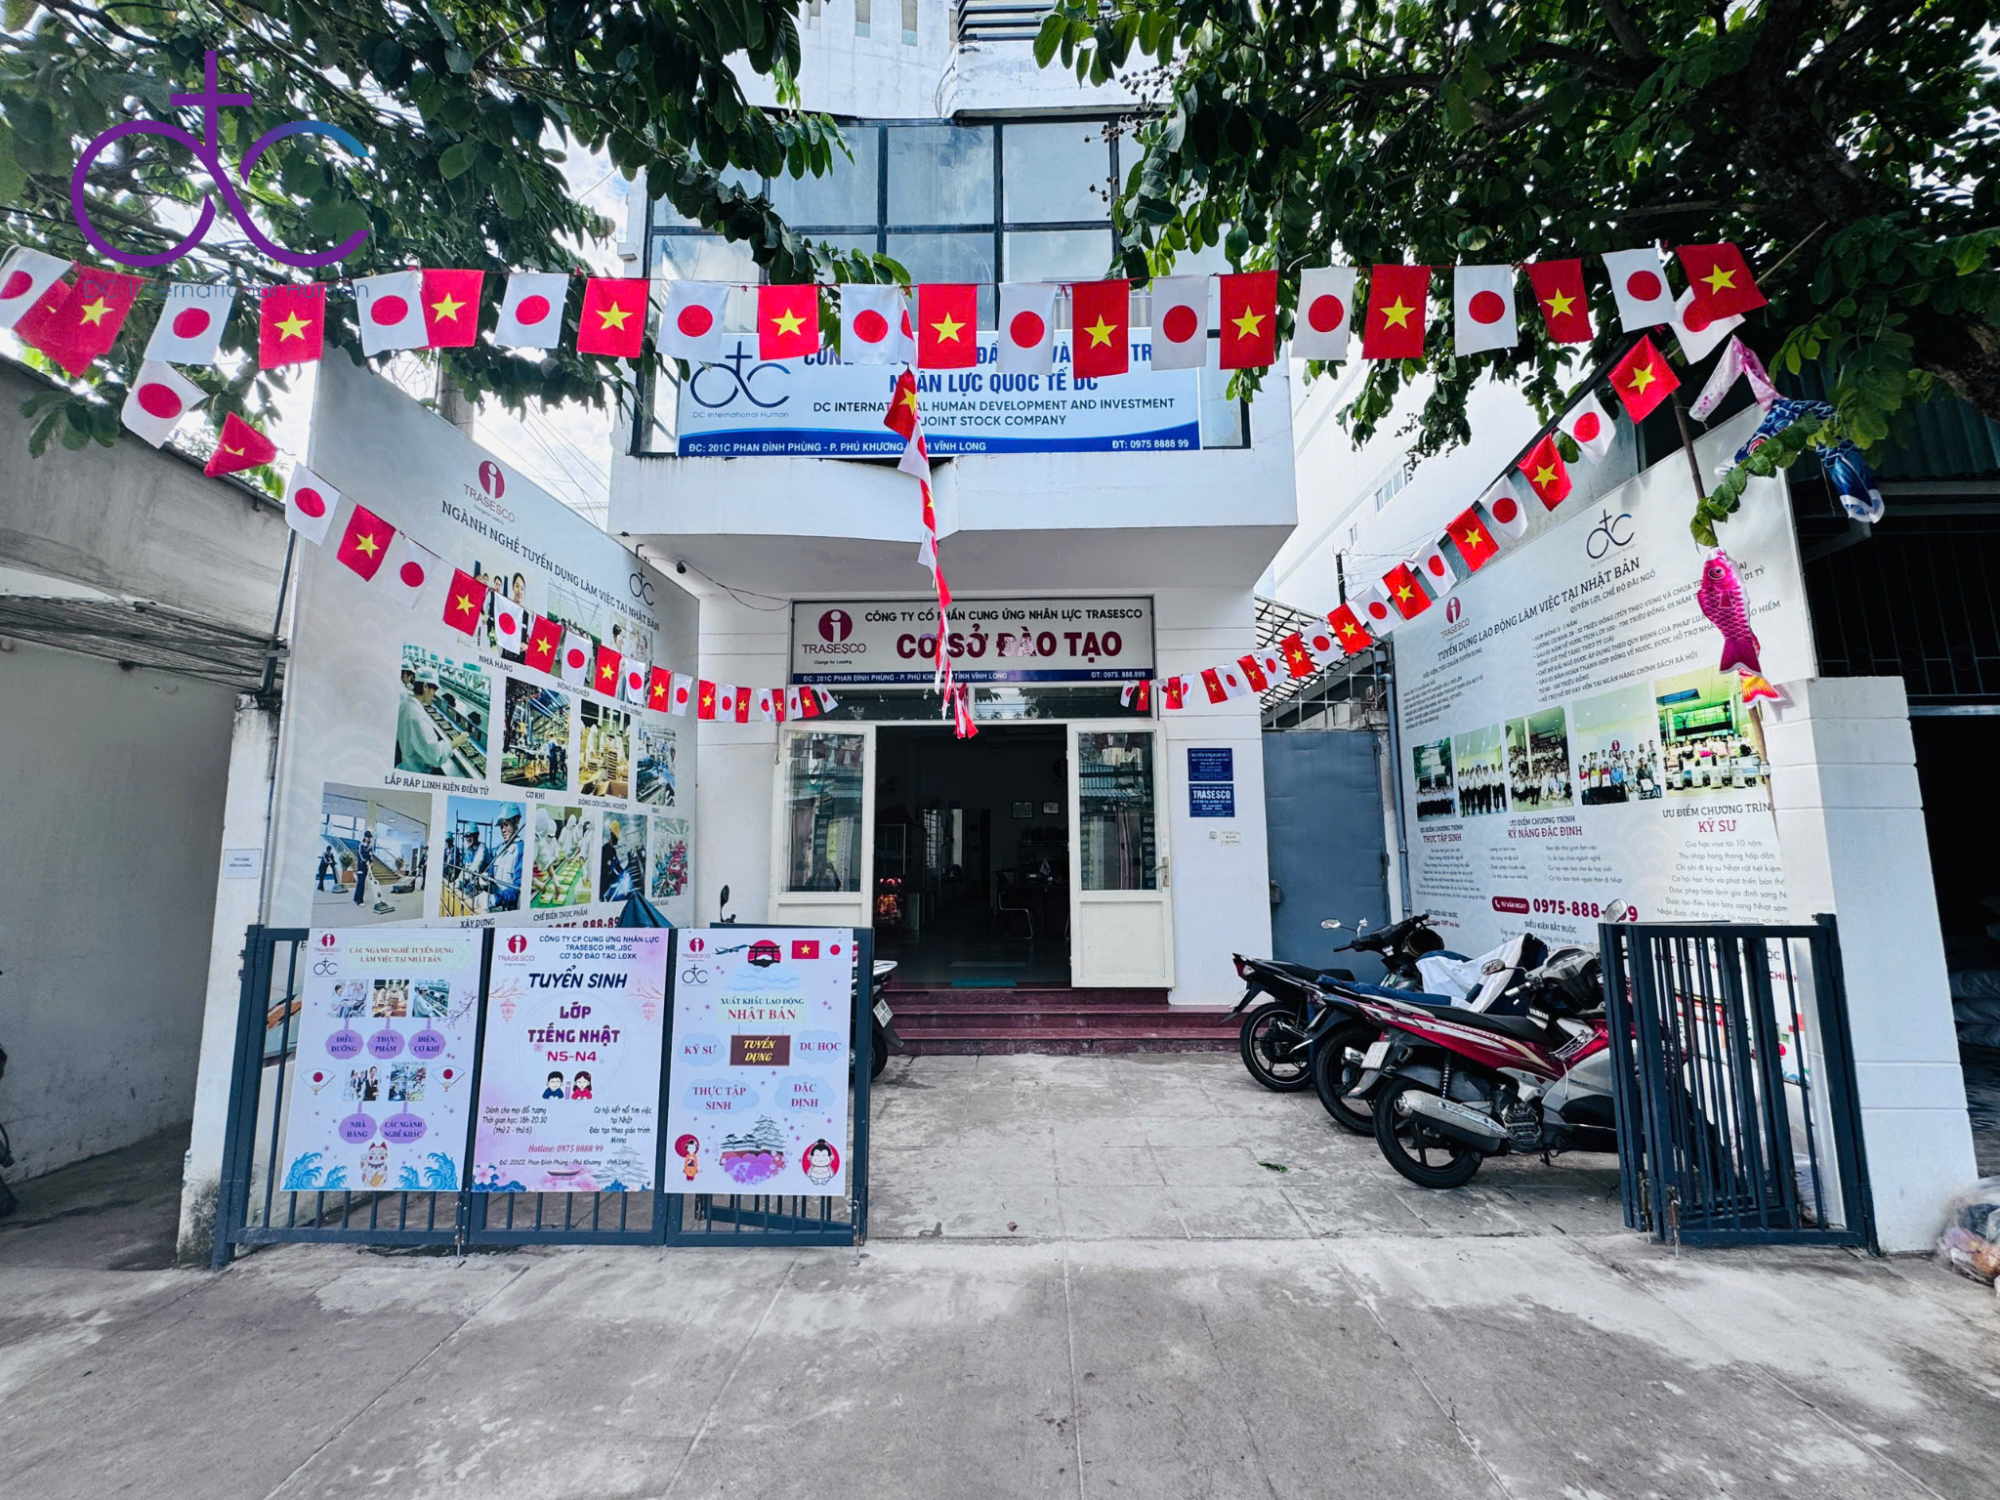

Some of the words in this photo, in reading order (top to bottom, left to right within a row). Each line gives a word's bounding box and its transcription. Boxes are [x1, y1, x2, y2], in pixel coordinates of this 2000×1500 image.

[948, 372, 983, 397] LỰC
[1074, 377, 1098, 391] DC
[813, 402, 832, 412] DC
[932, 401, 976, 412] HUMAN
[979, 400, 1067, 411] DEVELOPMENT
[1070, 399, 1097, 410] AND
[1100, 398, 1175, 409] INVESTMENT
[707, 411, 759, 419] International
[920, 416, 956, 427] JOINT
[960, 416, 1001, 426] STOCK
[1004, 415, 1067, 426] COMPANY
[688, 444, 706, 452] ĐC:
[708, 443, 731, 452] 201C
[733, 443, 759, 452] PHAN
[761, 441, 784, 452] ĐÌNH
[795, 441, 821, 452] PHÙNG
[830, 443, 837, 451] P.
[840, 441, 860, 451] PHÚ
[934, 439, 957, 451] VĨNH
[959, 441, 987, 451] LONG
[1112, 439, 1128, 449] ĐT:
[1130, 439, 1152, 449] 0975
[1153, 439, 1176, 449] 8888
[1178, 438, 1189, 448] 99
[463, 483, 516, 523] TRASESCO
[441, 500, 487, 536] NGÀNH
[489, 526, 521, 554] NGHỀ
[521, 545, 553, 572] TUYỂN
[554, 564, 579, 587] DỤNG
[580, 577, 598, 598] LÀM
[1478, 627, 1493, 643] LAO
[1518, 603, 1538, 623] LÀM
[1538, 594, 1561, 614] VIỆC
[1561, 585, 1579, 603] TẠI
[1580, 570, 1612, 596] NHẬT
[1614, 556, 1641, 580] BẢN
[865, 610, 897, 622] CÔNG
[900, 611, 915, 622] TY
[917, 609, 935, 622] CỔ
[968, 610, 999, 620] CUNG
[1002, 607, 1026, 620] ỨNG
[1029, 607, 1058, 620] NHÂN
[1061, 609, 1082, 622] LỰC
[1085, 608, 1143, 620] TRASESCO
[801, 643, 867, 655] TRASESCO
[1063, 630, 1123, 664] TẠO
[384, 772, 402, 785] LẮP
[403, 775, 421, 788] RÁP
[421, 780, 441, 790] LINH
[442, 782, 461, 793] KIỆN
[1192, 790, 1231, 800] TRASESCO
[1676, 804, 1699, 818] ĐIỂM
[1744, 800, 1771, 813] TRÌN
[1698, 817, 1715, 833] KỸ
[1718, 819, 1737, 832] SƯ
[539, 935, 561, 943] CÔNG
[605, 935, 622, 943] ỨNG
[623, 935, 643, 943] NHÂN
[644, 936, 660, 944] LỰC
[584, 951, 600, 960] ĐÀO
[601, 953, 617, 961] TẠO
[528, 964, 584, 989] TUYỂN
[587, 973, 628, 989] SINH
[720, 995, 741, 1005] XUẤT
[782, 997, 805, 1006] ĐỘNG
[559, 1001, 592, 1020] LỚP
[727, 1006, 766, 1023] NHẬT
[769, 1006, 796, 1020] BẢN
[527, 1022, 576, 1043] TIẾNG
[579, 1024, 621, 1047] NHẬT
[684, 1043, 701, 1055] KỸ
[701, 1043, 717, 1055] SƯ
[743, 1035, 777, 1050] TUYỂN
[800, 1042, 815, 1051] DU
[817, 1042, 842, 1053] HỌC
[547, 1050, 598, 1062] N5-N4
[744, 1052, 773, 1063] DỤNG
[692, 1085, 724, 1098] THỰC
[724, 1084, 747, 1097] TẬP
[793, 1082, 818, 1095] ĐẶC
[705, 1100, 732, 1111] SINH
[790, 1097, 819, 1108] ĐỊNH
[505, 1126, 511, 1134] 2
[528, 1144, 554, 1153] Hotline:
[556, 1144, 574, 1153] 0975
[575, 1144, 593, 1153] 8888
[594, 1144, 604, 1152] 99
